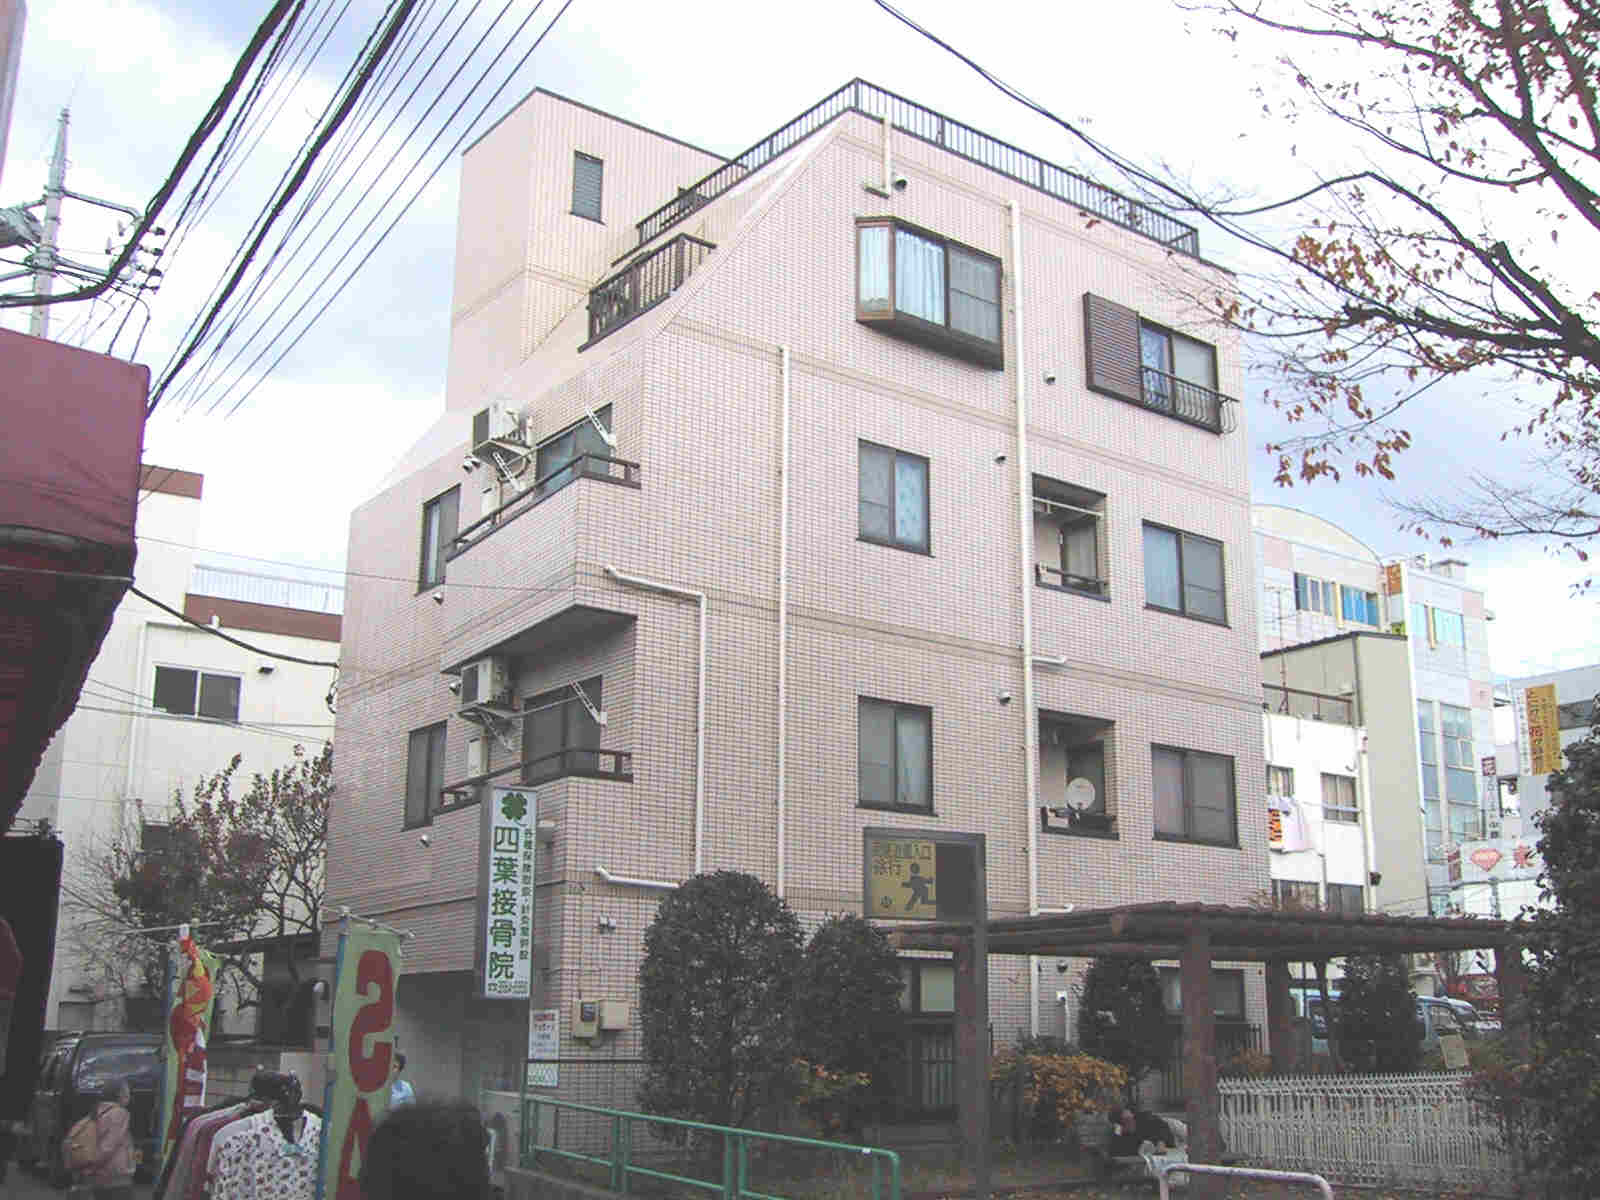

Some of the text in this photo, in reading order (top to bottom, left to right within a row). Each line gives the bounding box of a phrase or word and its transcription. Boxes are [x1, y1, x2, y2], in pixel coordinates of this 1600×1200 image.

[488, 826, 519, 981] 四葉接骨院
